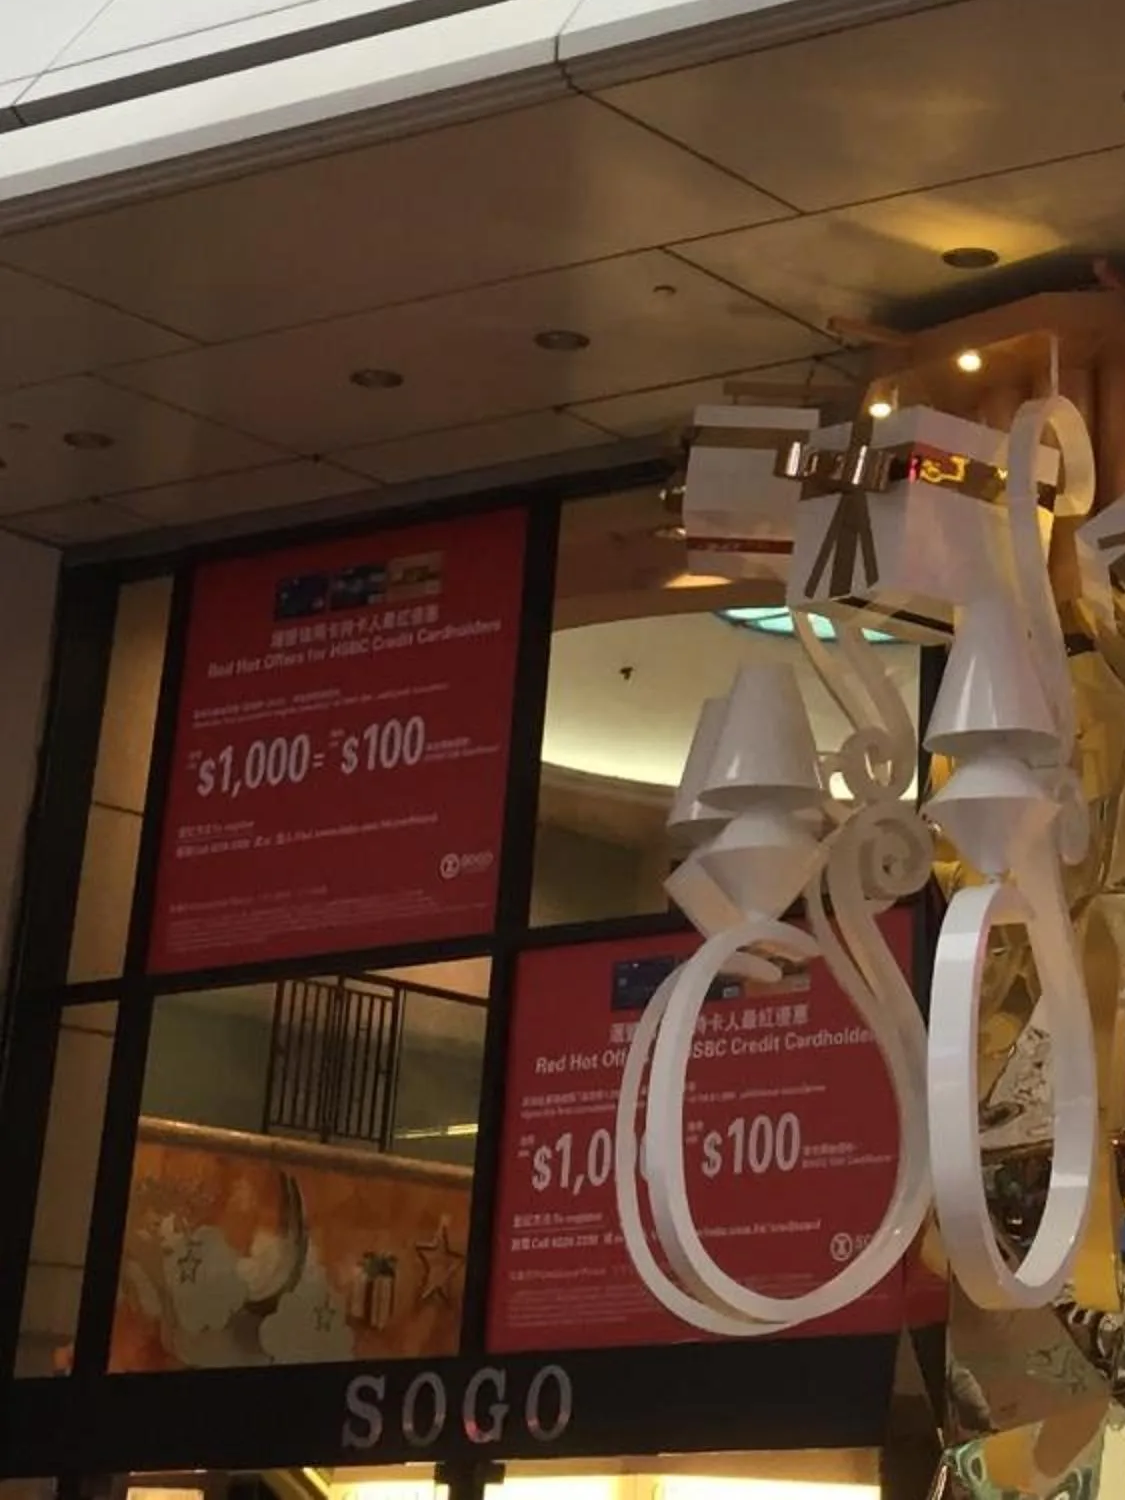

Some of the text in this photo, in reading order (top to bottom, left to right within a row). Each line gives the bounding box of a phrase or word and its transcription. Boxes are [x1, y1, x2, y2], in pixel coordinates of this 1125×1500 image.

[340, 716, 425, 775] $100
[535, 1056, 566, 1074] Red
[569, 1052, 598, 1072] Hot
[690, 1039, 728, 1060] SBC
[731, 1032, 781, 1056] Credit
[785, 1026, 876, 1051] Cardholde
[702, 1111, 801, 1179] $100
[341, 1363, 574, 1448] SOGO
